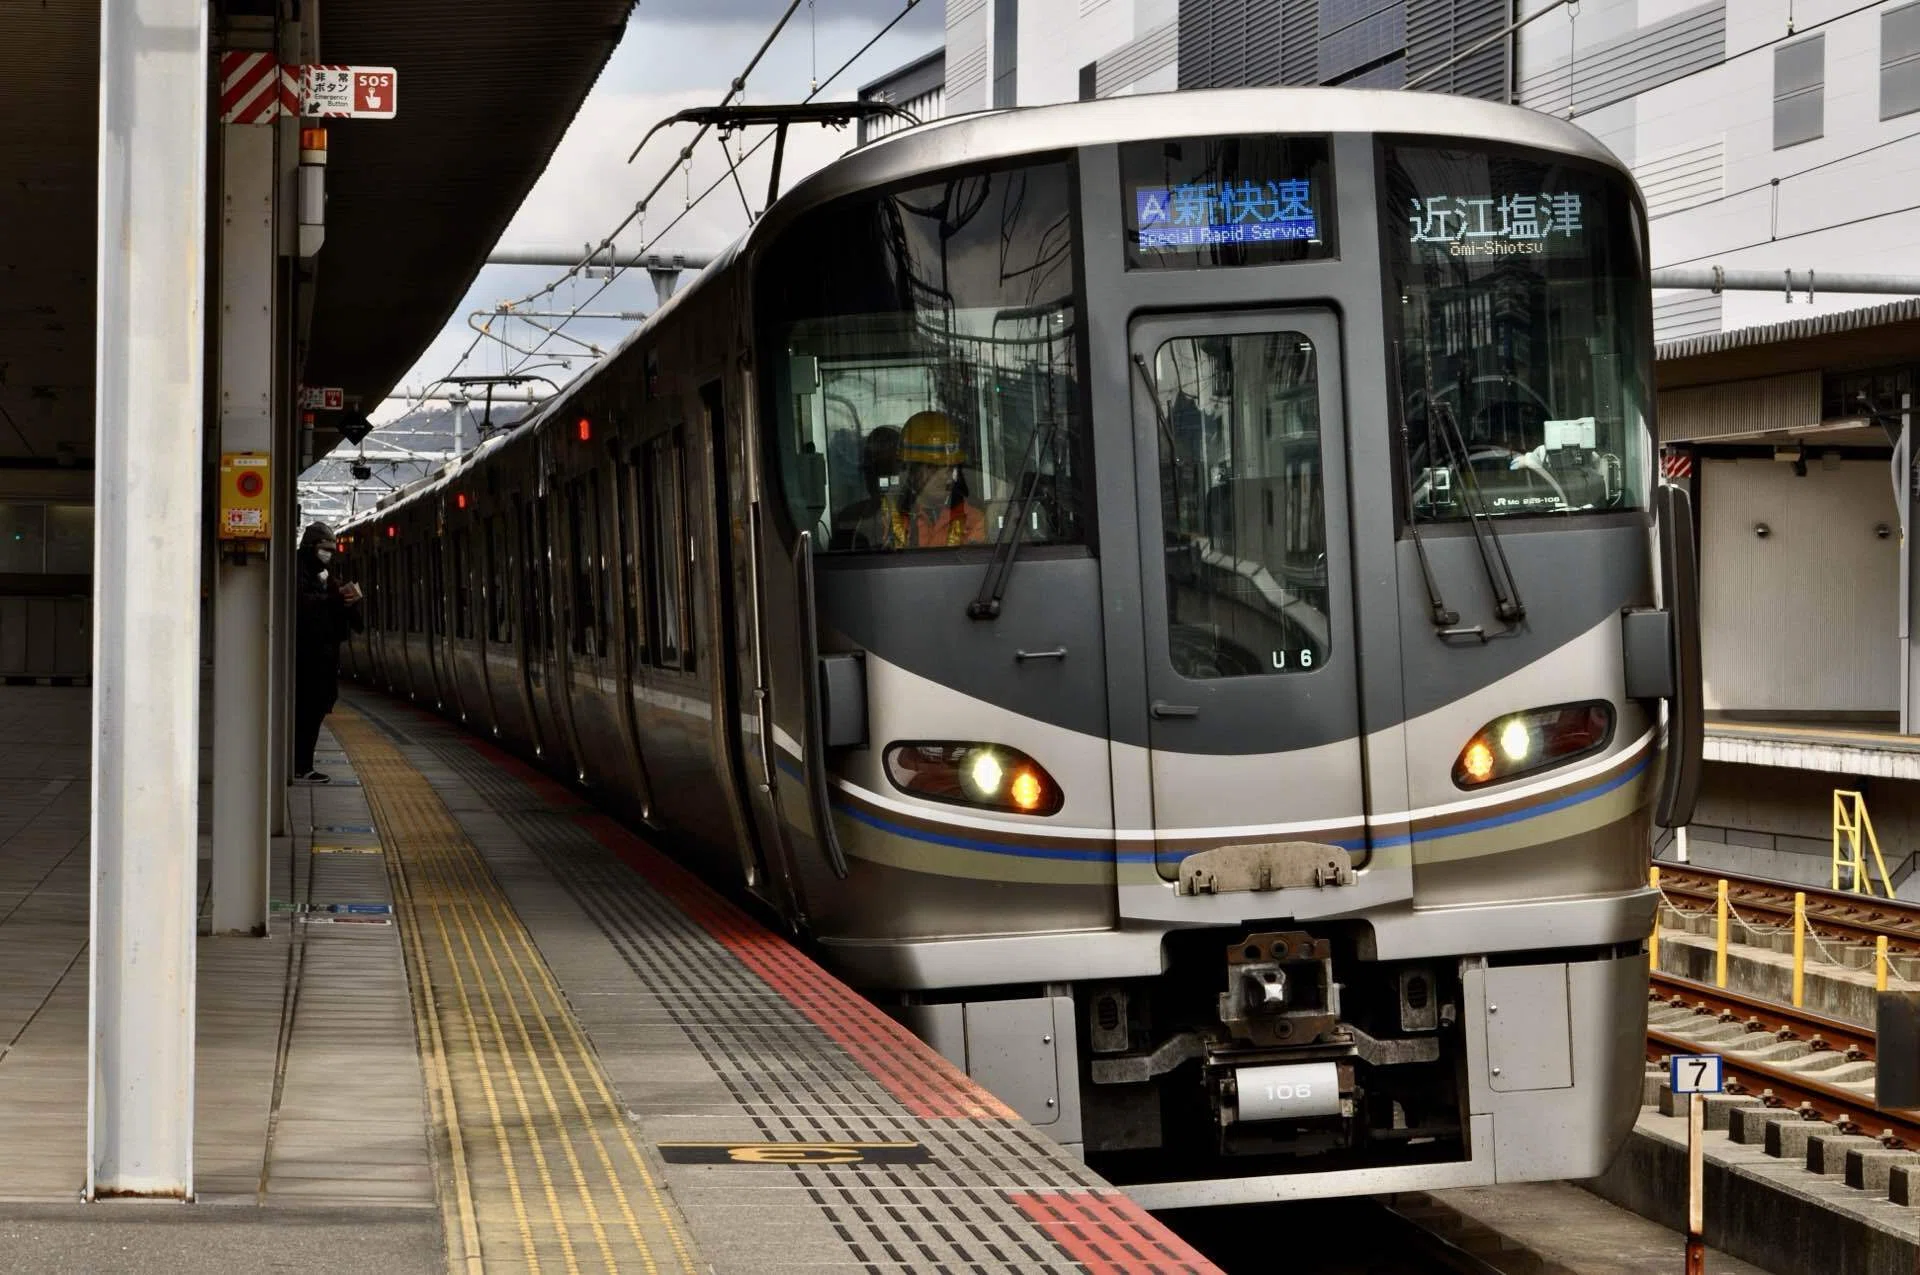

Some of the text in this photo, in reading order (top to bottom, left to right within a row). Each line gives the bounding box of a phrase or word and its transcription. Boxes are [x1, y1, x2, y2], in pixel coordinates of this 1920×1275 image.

[314, 83, 348, 93] ボタン
[359, 76, 389, 87] SOS
[1173, 179, 1314, 226] 新快速
[1409, 191, 1583, 242] 近江塩津
[1140, 225, 1315, 246] Special Rapid Service
[1493, 497, 1506, 506] JR
[1272, 648, 1312, 669] U 6
[1688, 1061, 1707, 1087] 7
[1265, 1083, 1312, 1100] 106
